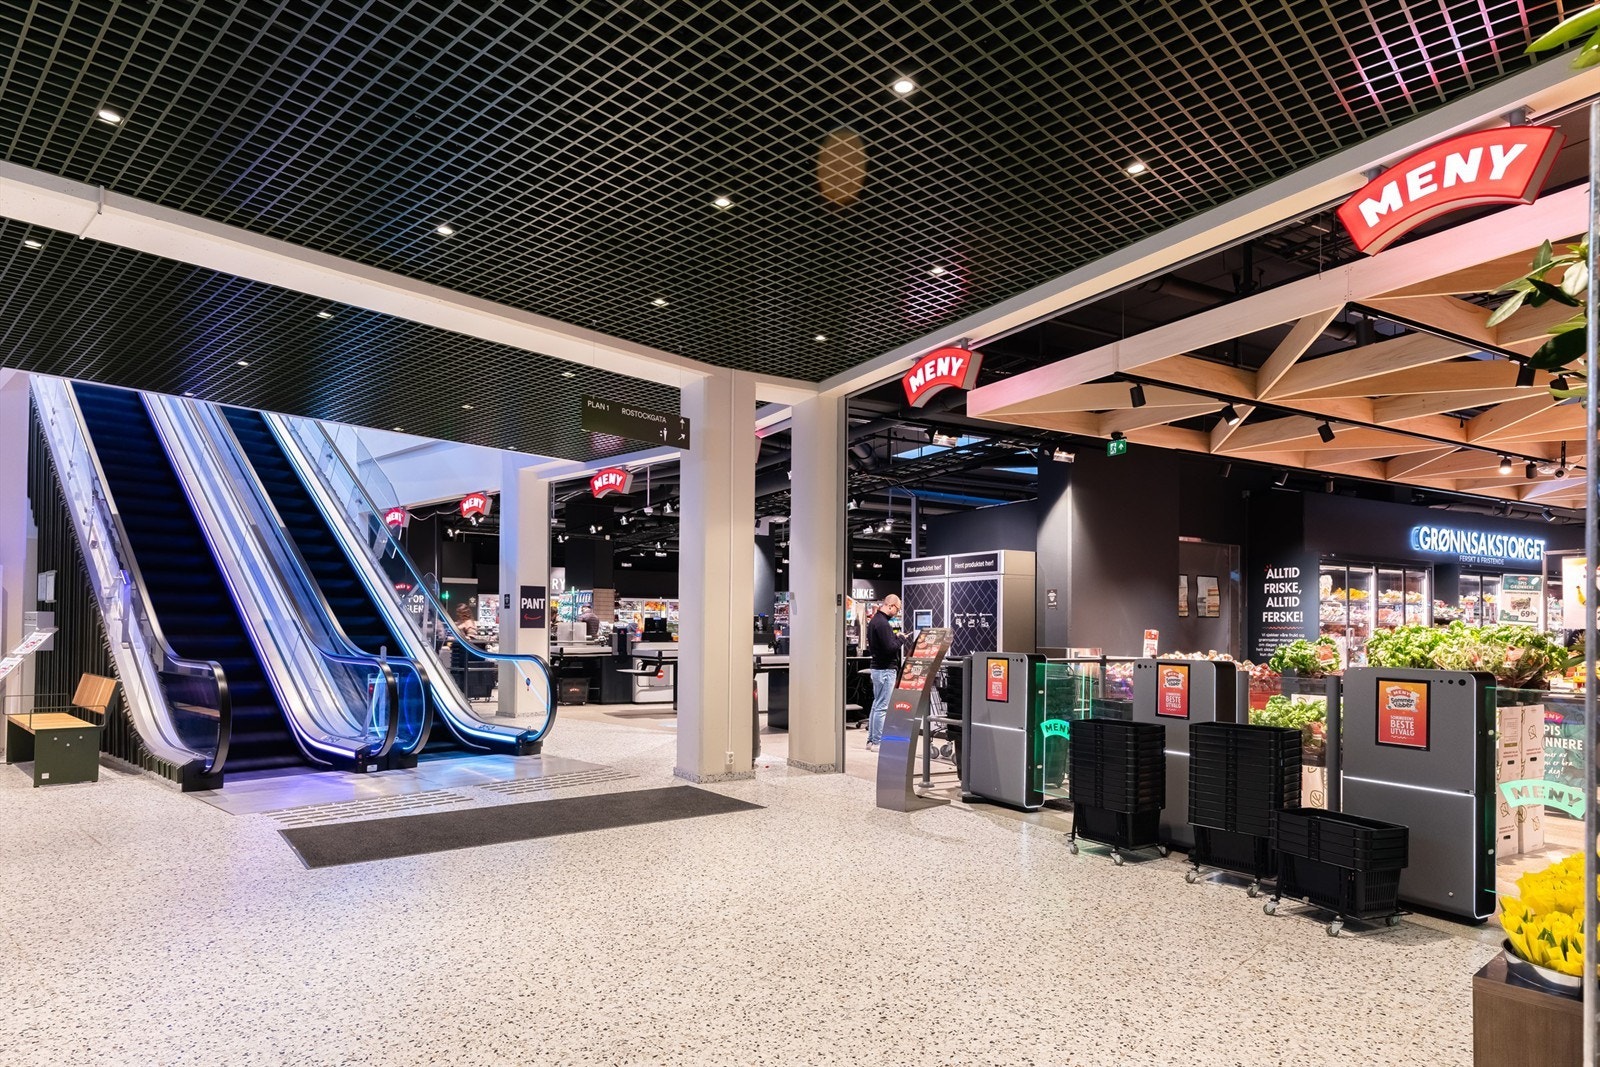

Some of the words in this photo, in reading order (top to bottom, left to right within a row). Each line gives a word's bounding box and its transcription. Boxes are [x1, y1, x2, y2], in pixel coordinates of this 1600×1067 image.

[1358, 143, 1527, 228] MENY
[909, 356, 964, 393] MENY
[587, 400, 606, 411] PLAN
[621, 407, 667, 423] ROSTOCKGATA
[594, 473, 623, 490] MENY
[462, 498, 484, 511] MENY
[386, 511, 403, 524] MENY
[1420, 526, 1545, 560] GRØNNSAKSTORGET
[1459, 555, 1476, 563] FERSKT
[1481, 556, 1504, 565] FRISTENDE
[1266, 567, 1300, 579] ALLTID
[1264, 582, 1302, 594] FRISKE,
[521, 598, 545, 609] PANT
[1266, 596, 1300, 607] ALLTID
[1262, 611, 1303, 622] FERSKE!
[1166, 695, 1181, 703] BESTE
[1393, 689, 1410, 697] MENY
[1390, 720, 1414, 729] BESTE
[1390, 728, 1415, 736] UTVALG
[1510, 786, 1582, 807] MENY
